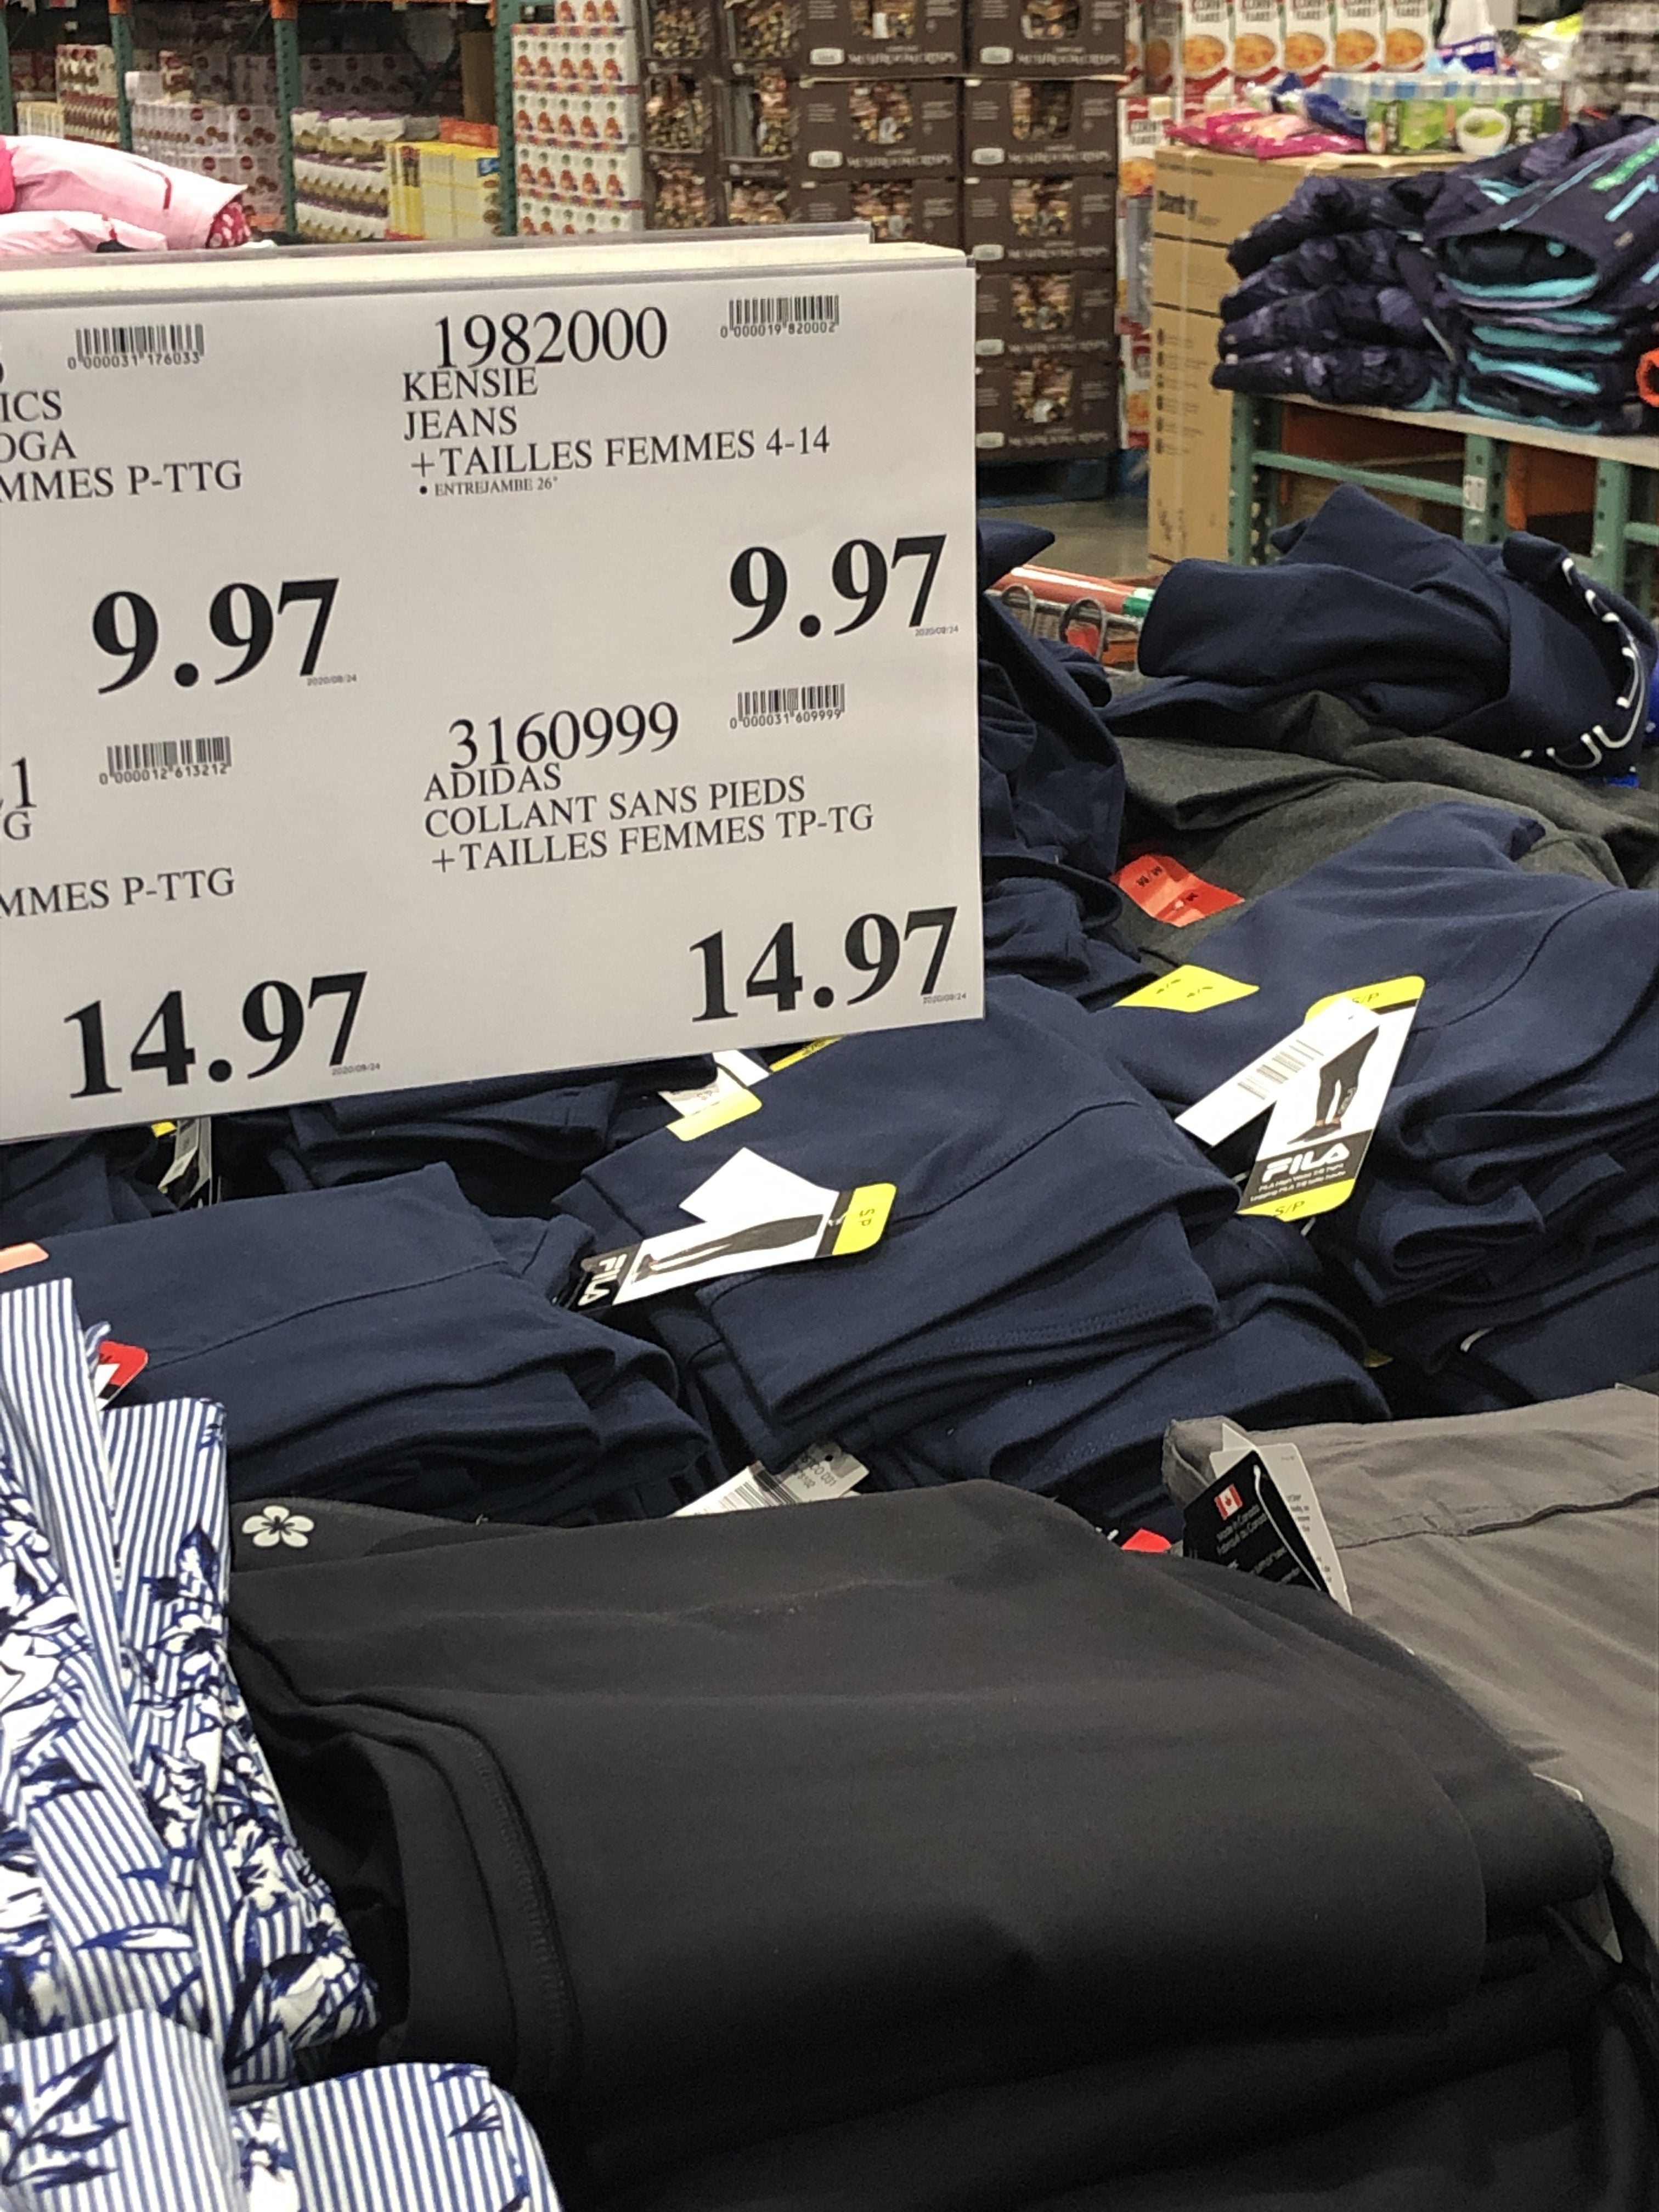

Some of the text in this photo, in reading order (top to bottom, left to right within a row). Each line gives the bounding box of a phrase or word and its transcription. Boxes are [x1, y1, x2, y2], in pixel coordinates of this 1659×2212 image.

[436, 307, 668, 368] 1982000
[720, 326, 728, 338] 0
[67, 357, 77, 370] 0
[403, 366, 538, 402] KENSIE
[404, 406, 517, 441] JEANS
[411, 425, 830, 477] +TAILLES FEMMES 4-14
[128, 460, 242, 495] P-TTG
[435, 479, 533, 496] ENTREJAMBE
[730, 534, 947, 644] 9.97
[92, 578, 339, 694] 9.97
[449, 702, 679, 769] 3160999
[730, 718, 737, 729] 0
[0, 757, 37, 810] 1
[99, 773, 108, 785] 0
[424, 762, 562, 802] ADIDAS
[425, 776, 805, 837] COLLANT SANS PIEDS
[432, 804, 873, 873] +TAILLES FEMMES TP-TG
[123, 867, 235, 906] P-TTG
[690, 906, 958, 1023] 14.97
[64, 971, 368, 1098] 14.97
[1262, 1142, 1350, 1183] FILA
[577, 1254, 628, 1306] FILA
